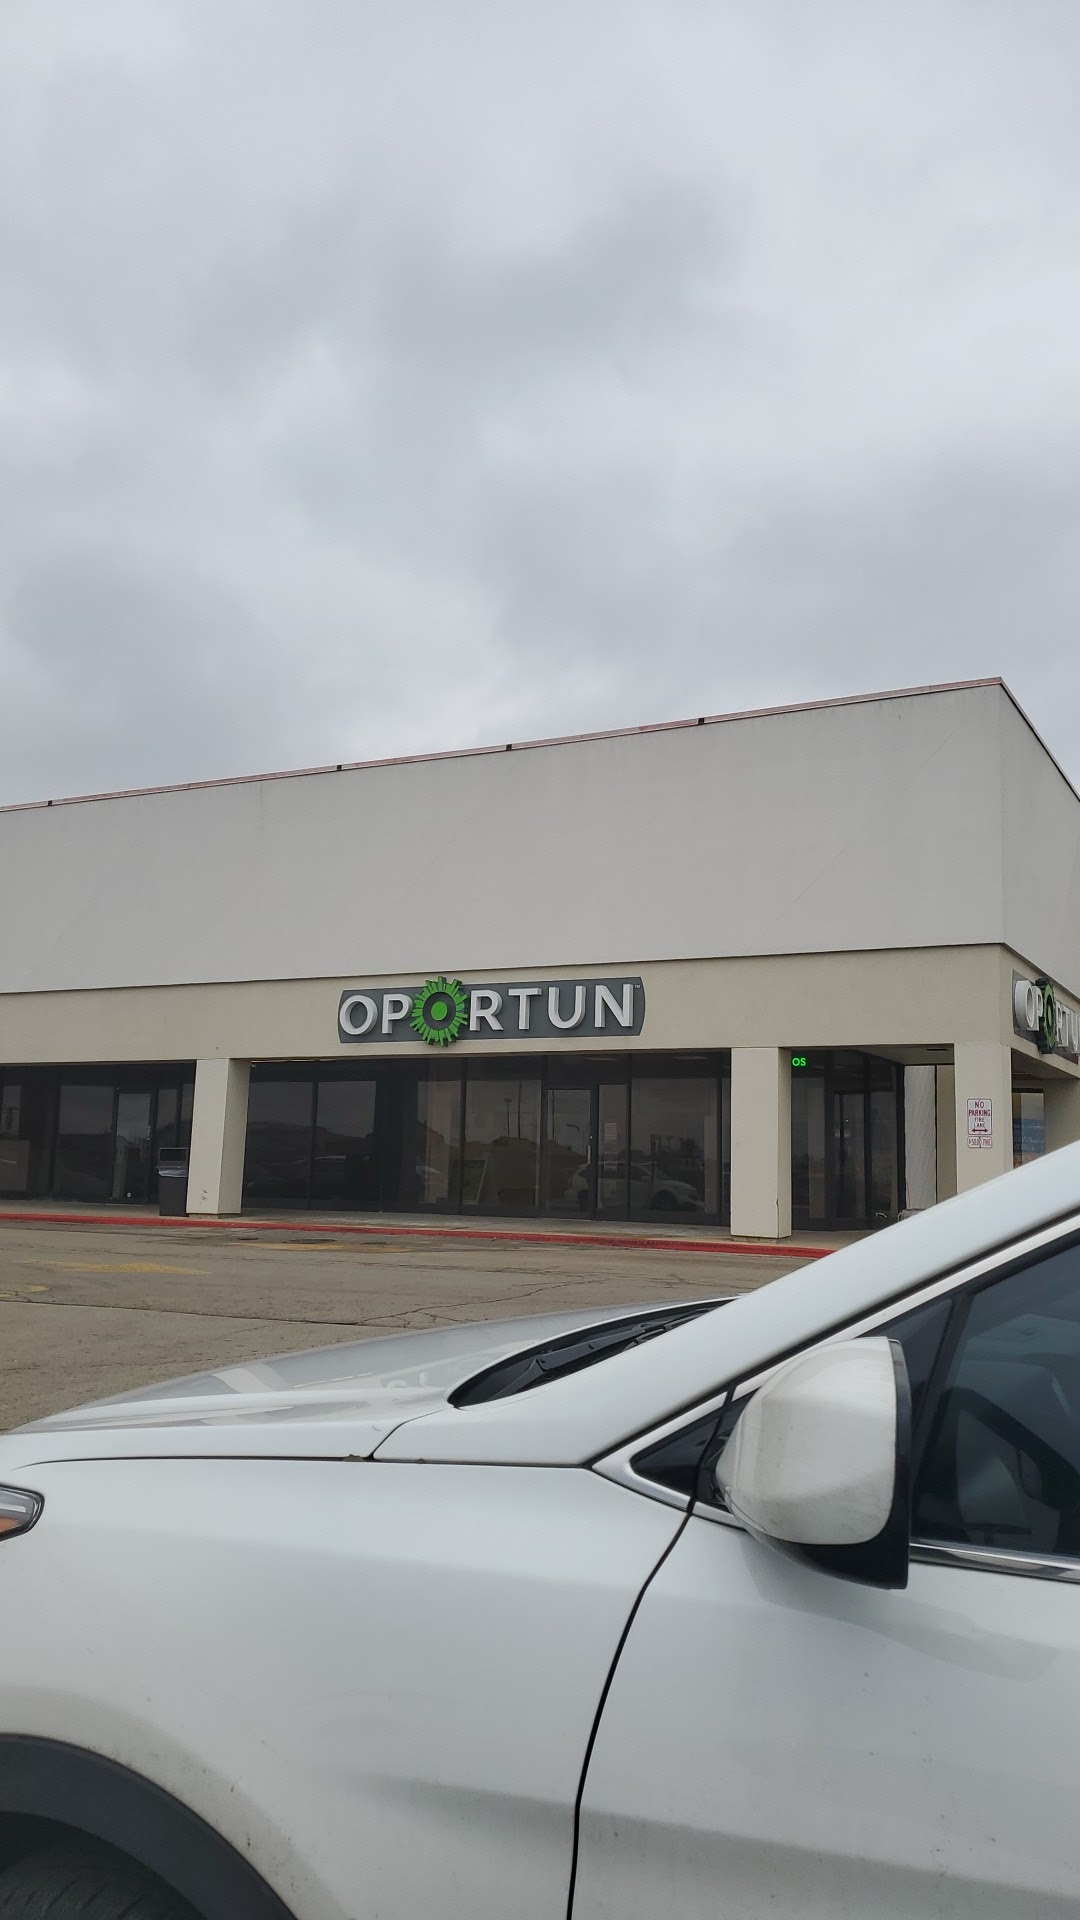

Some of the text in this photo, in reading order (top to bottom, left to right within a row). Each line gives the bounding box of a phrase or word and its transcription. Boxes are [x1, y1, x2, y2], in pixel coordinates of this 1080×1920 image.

[339, 976, 634, 1046] OPORTUN
[974, 1101, 985, 1109] NO
[968, 1109, 991, 1117] PARKING
